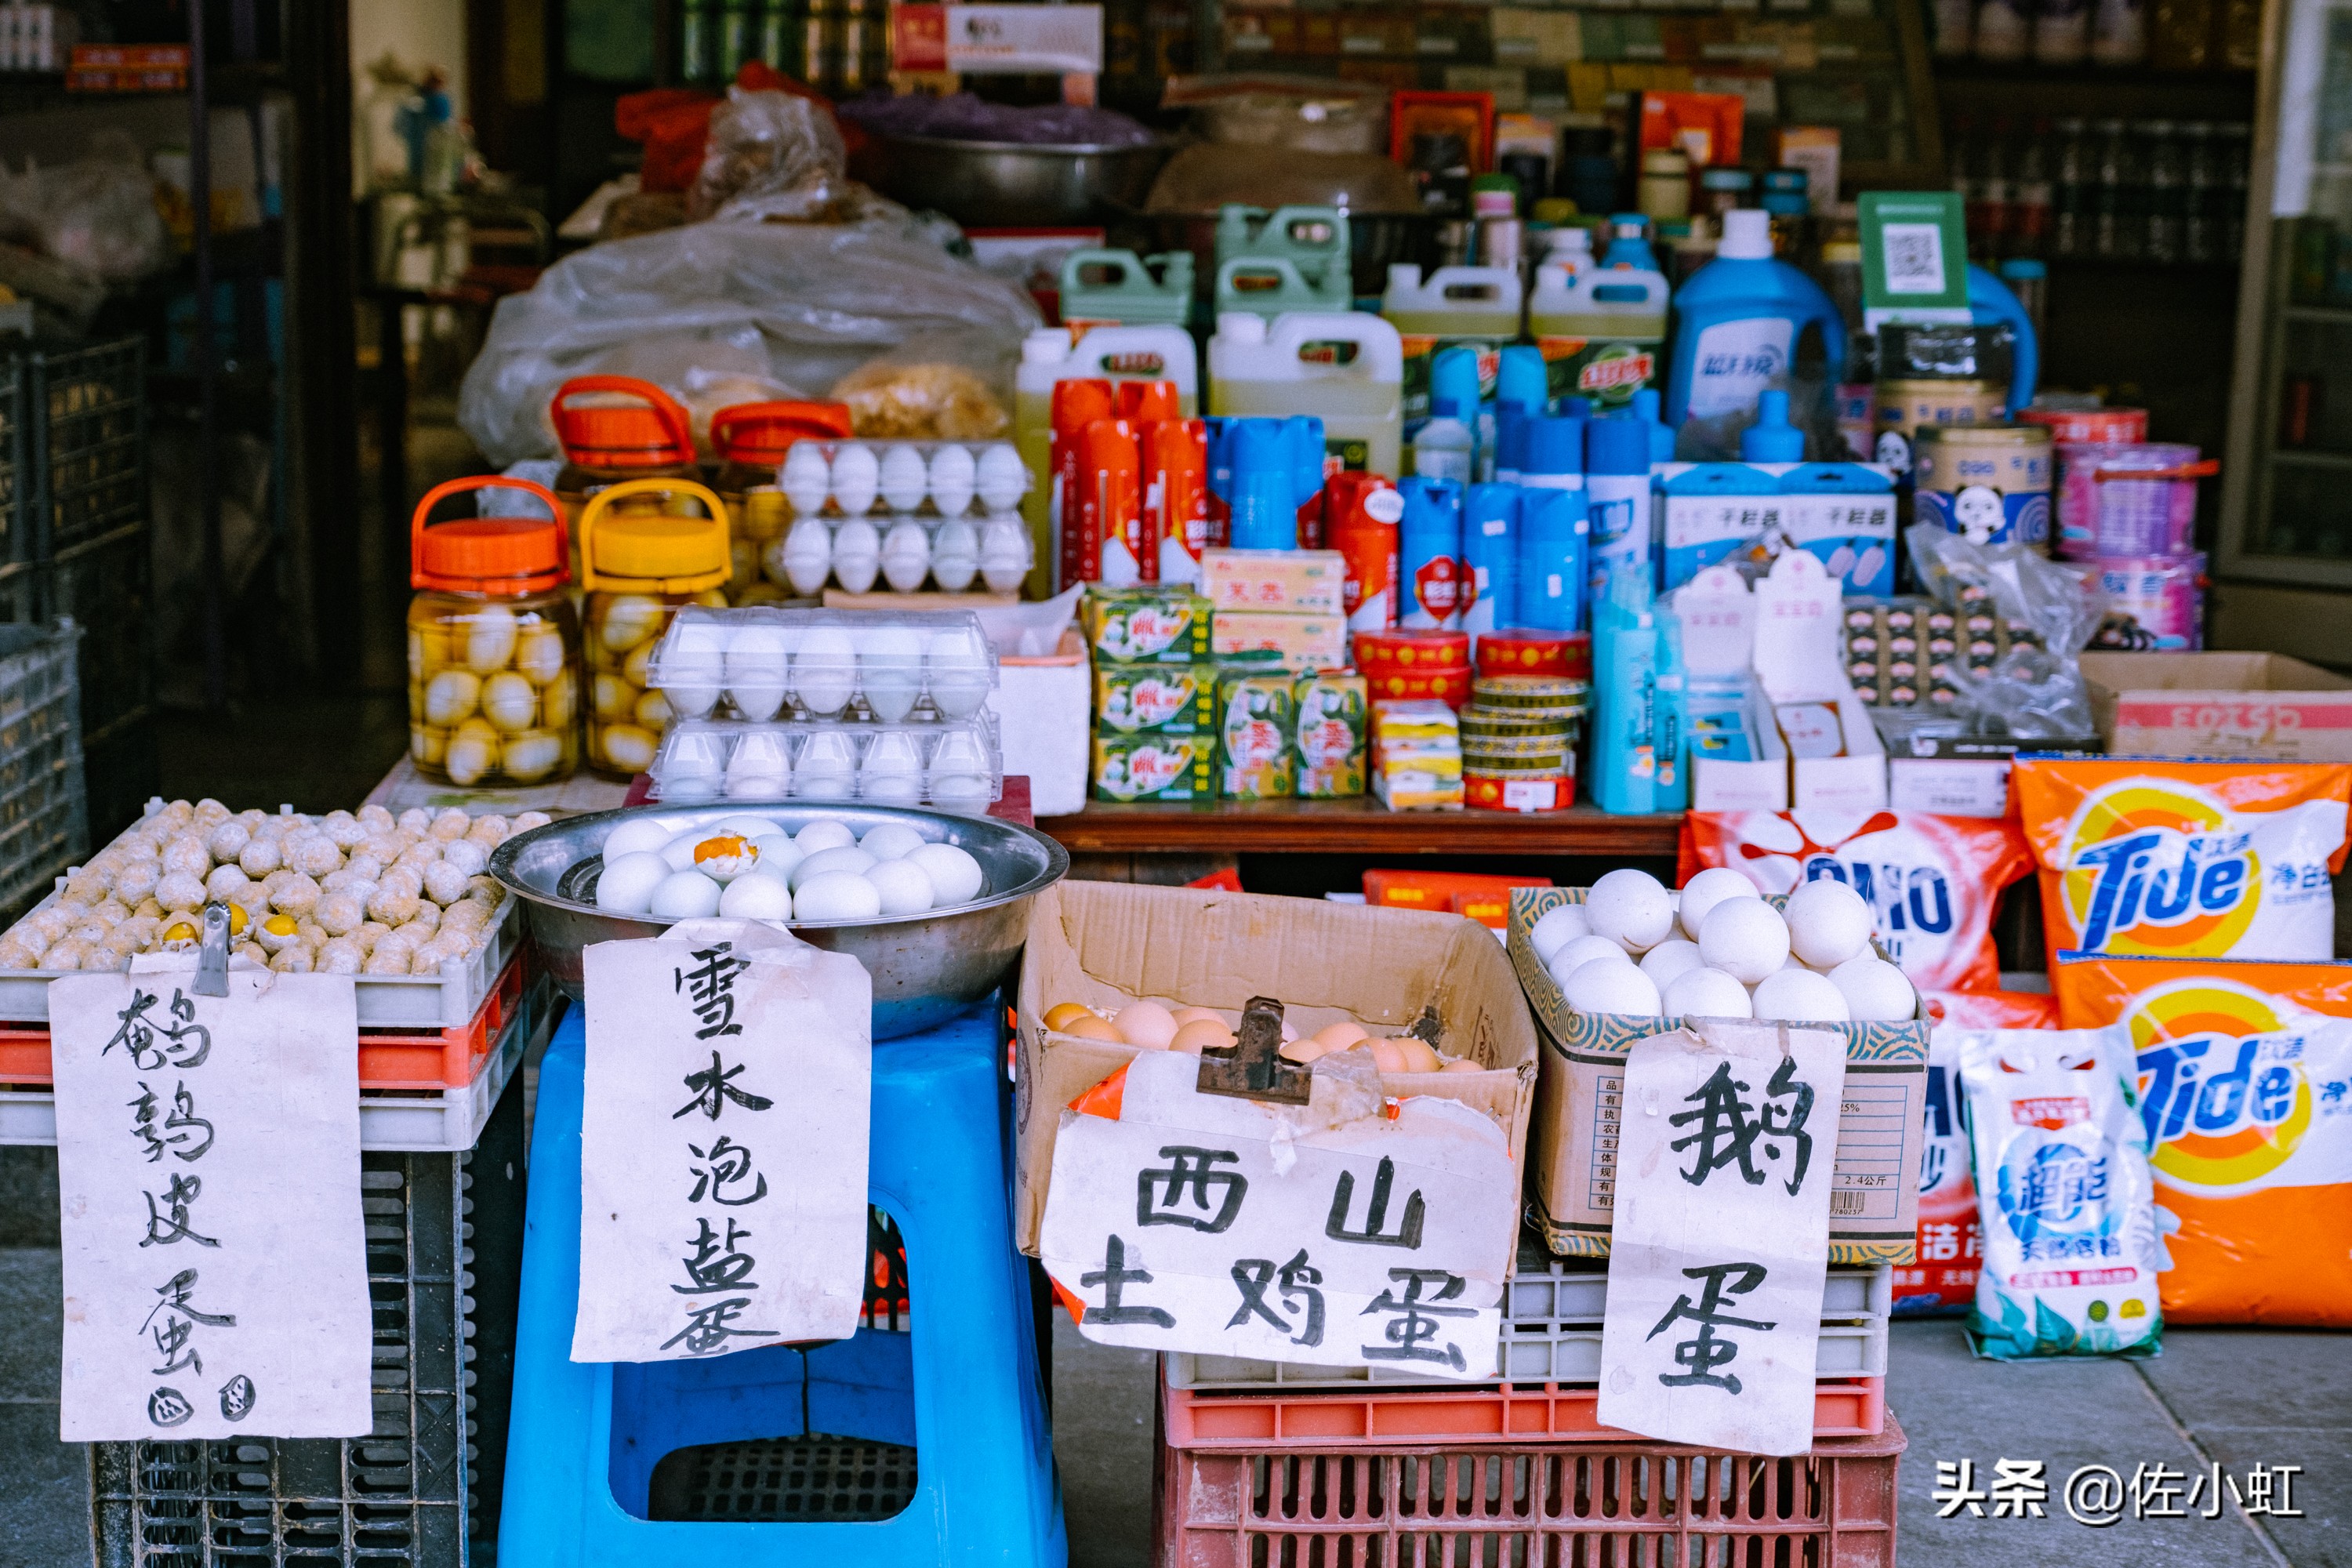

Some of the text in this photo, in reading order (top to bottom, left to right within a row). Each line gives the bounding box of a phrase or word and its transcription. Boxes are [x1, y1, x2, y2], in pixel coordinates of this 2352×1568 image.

[2078, 833, 2245, 951] Tide
[659, 941, 781, 1359] 雪水泡盐蛋
[2136, 1040, 2291, 1152] Tide
[1136, 1145, 1426, 1250] 西山
[1645, 1055, 1815, 1396] 鹅蛋
[1080, 1233, 1479, 1373] 土鸡蛋
